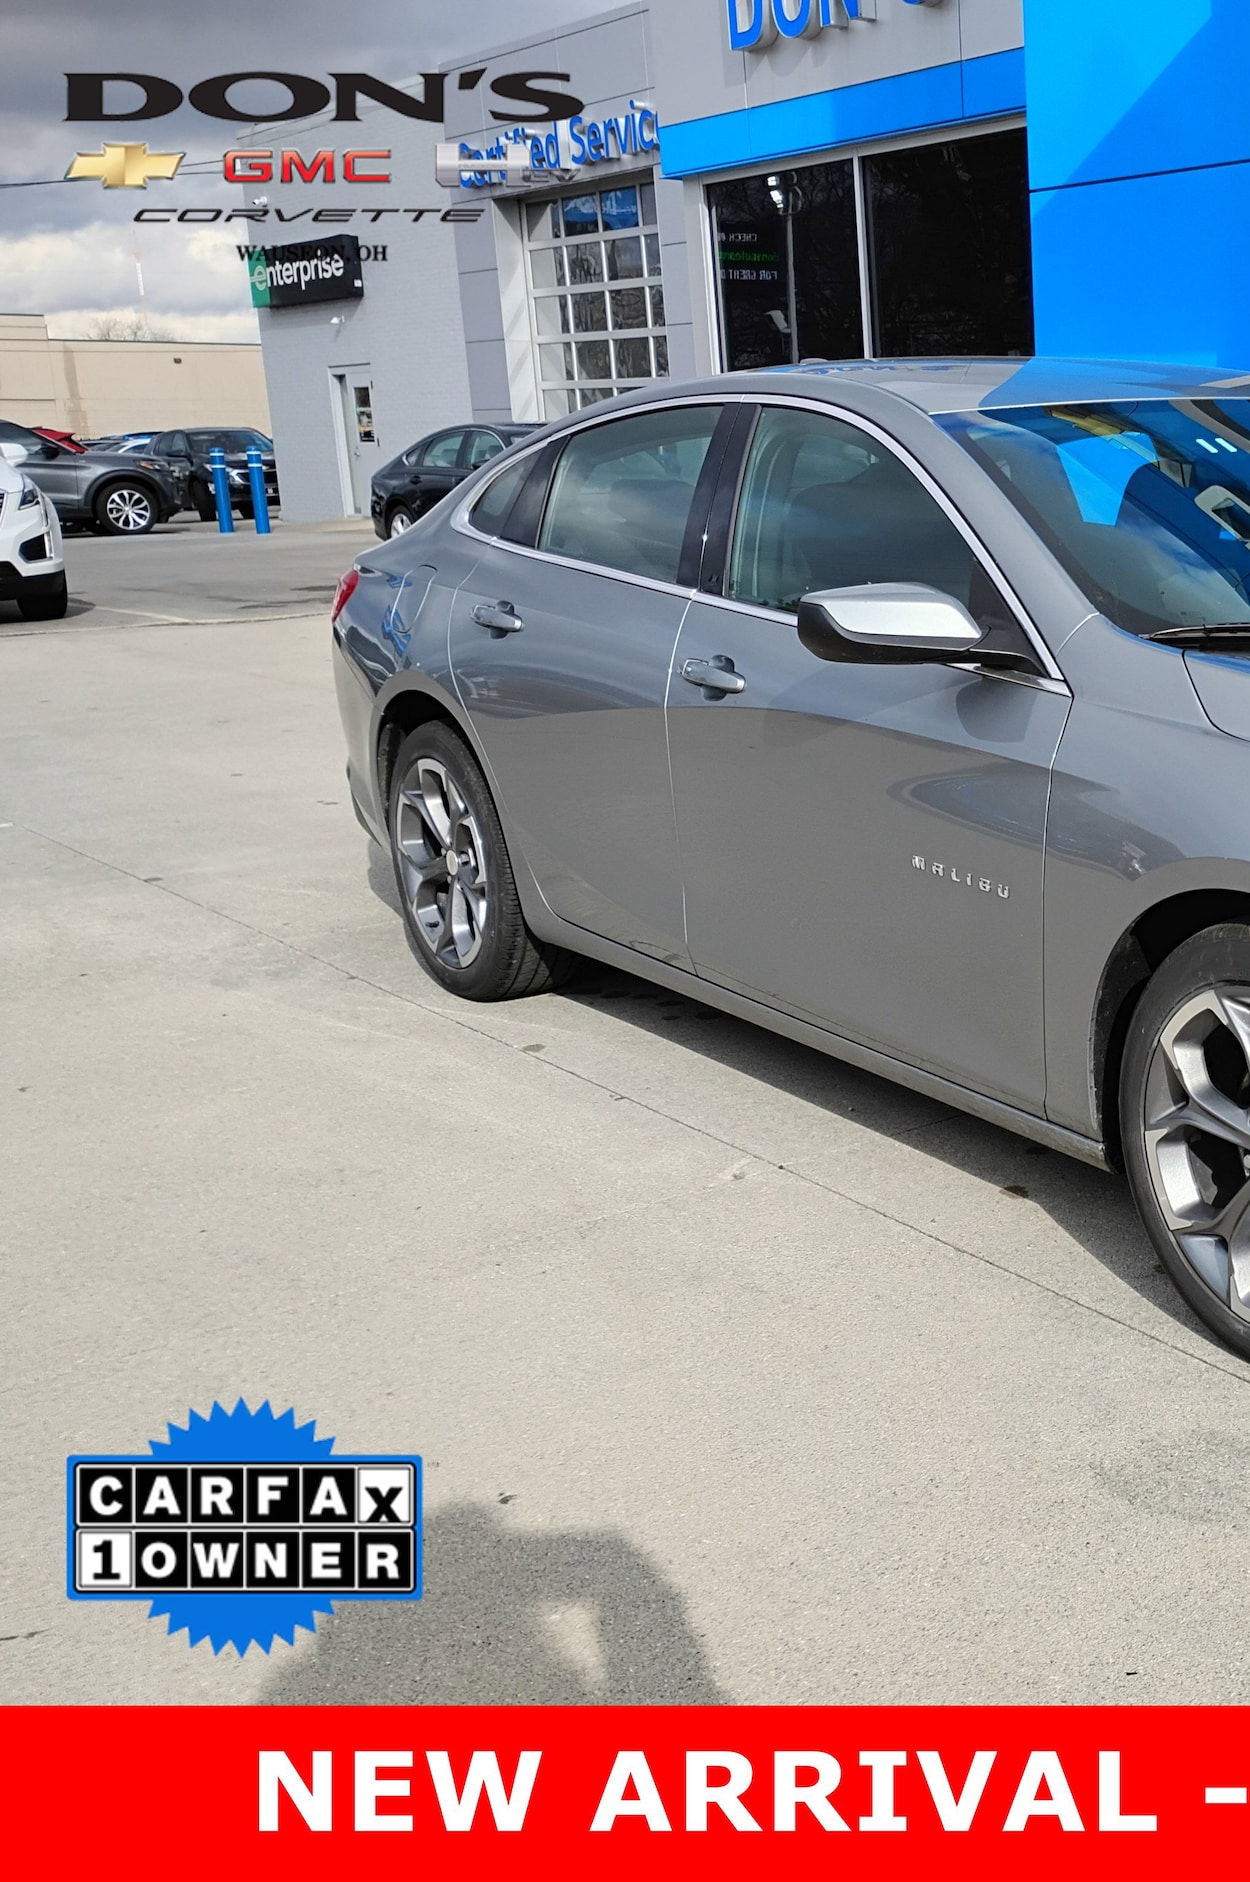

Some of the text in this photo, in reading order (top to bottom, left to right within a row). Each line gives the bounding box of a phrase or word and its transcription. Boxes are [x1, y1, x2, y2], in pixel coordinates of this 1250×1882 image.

[459, 99, 661, 189] Certed Servic
[250, 249, 345, 291] enterprise
[911, 855, 1010, 899] MALIBU
